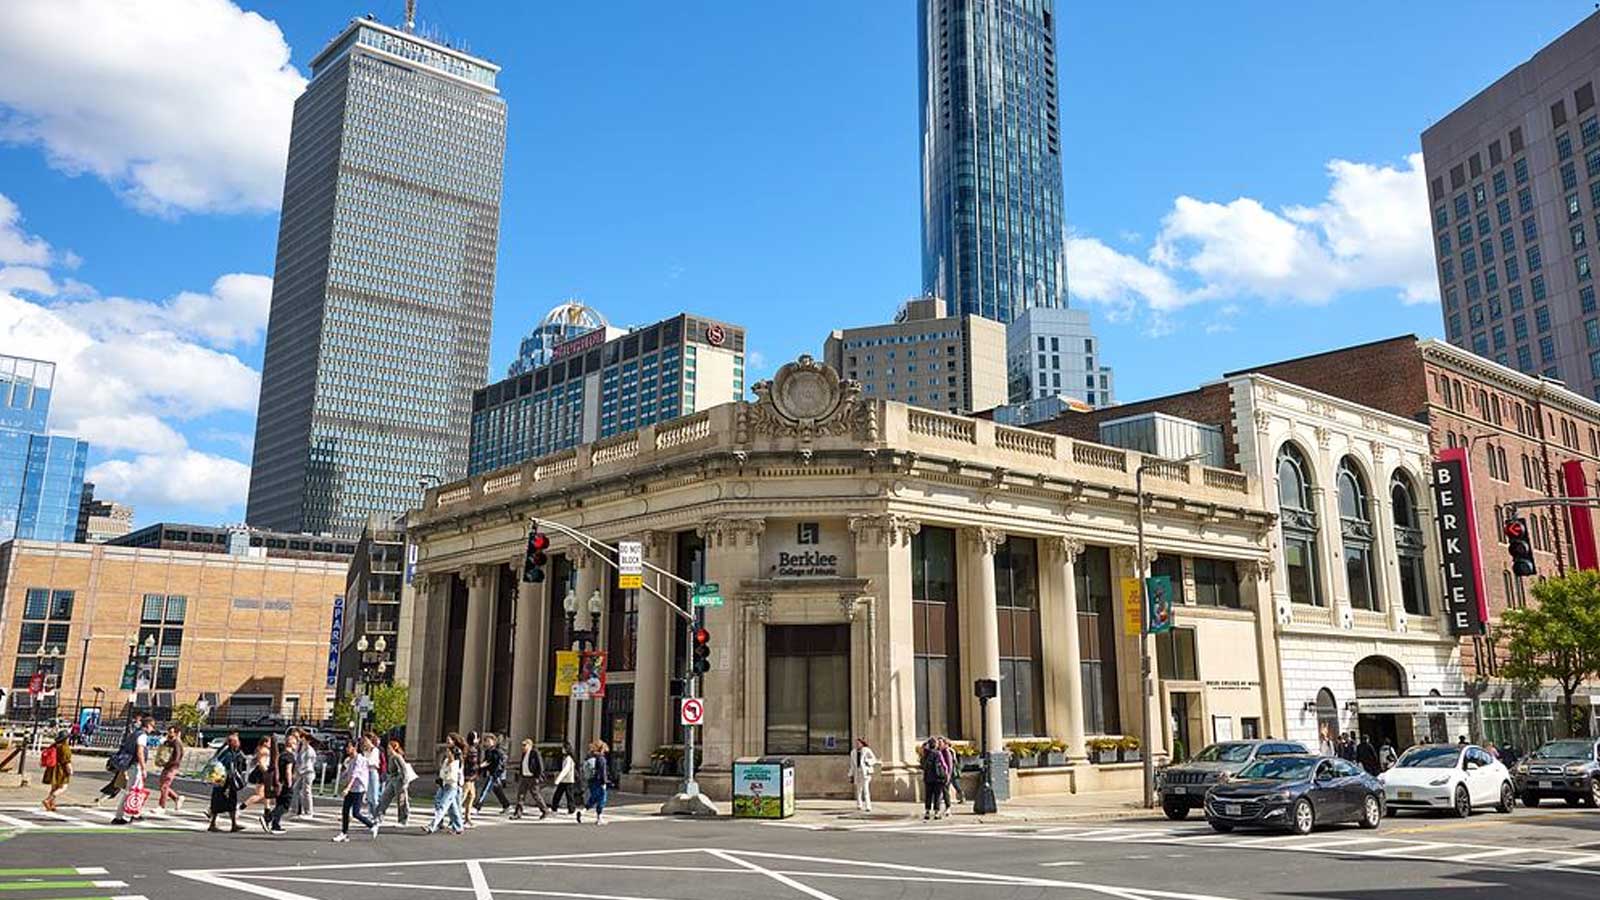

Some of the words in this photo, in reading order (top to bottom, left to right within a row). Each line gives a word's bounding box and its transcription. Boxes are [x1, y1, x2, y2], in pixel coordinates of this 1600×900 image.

[620, 545, 629, 554] DO
[630, 545, 641, 554] NOT
[1438, 468, 1469, 628] BERKLEE
[622, 556, 640, 564] BLOCK
[779, 551, 837, 567] Berklee
